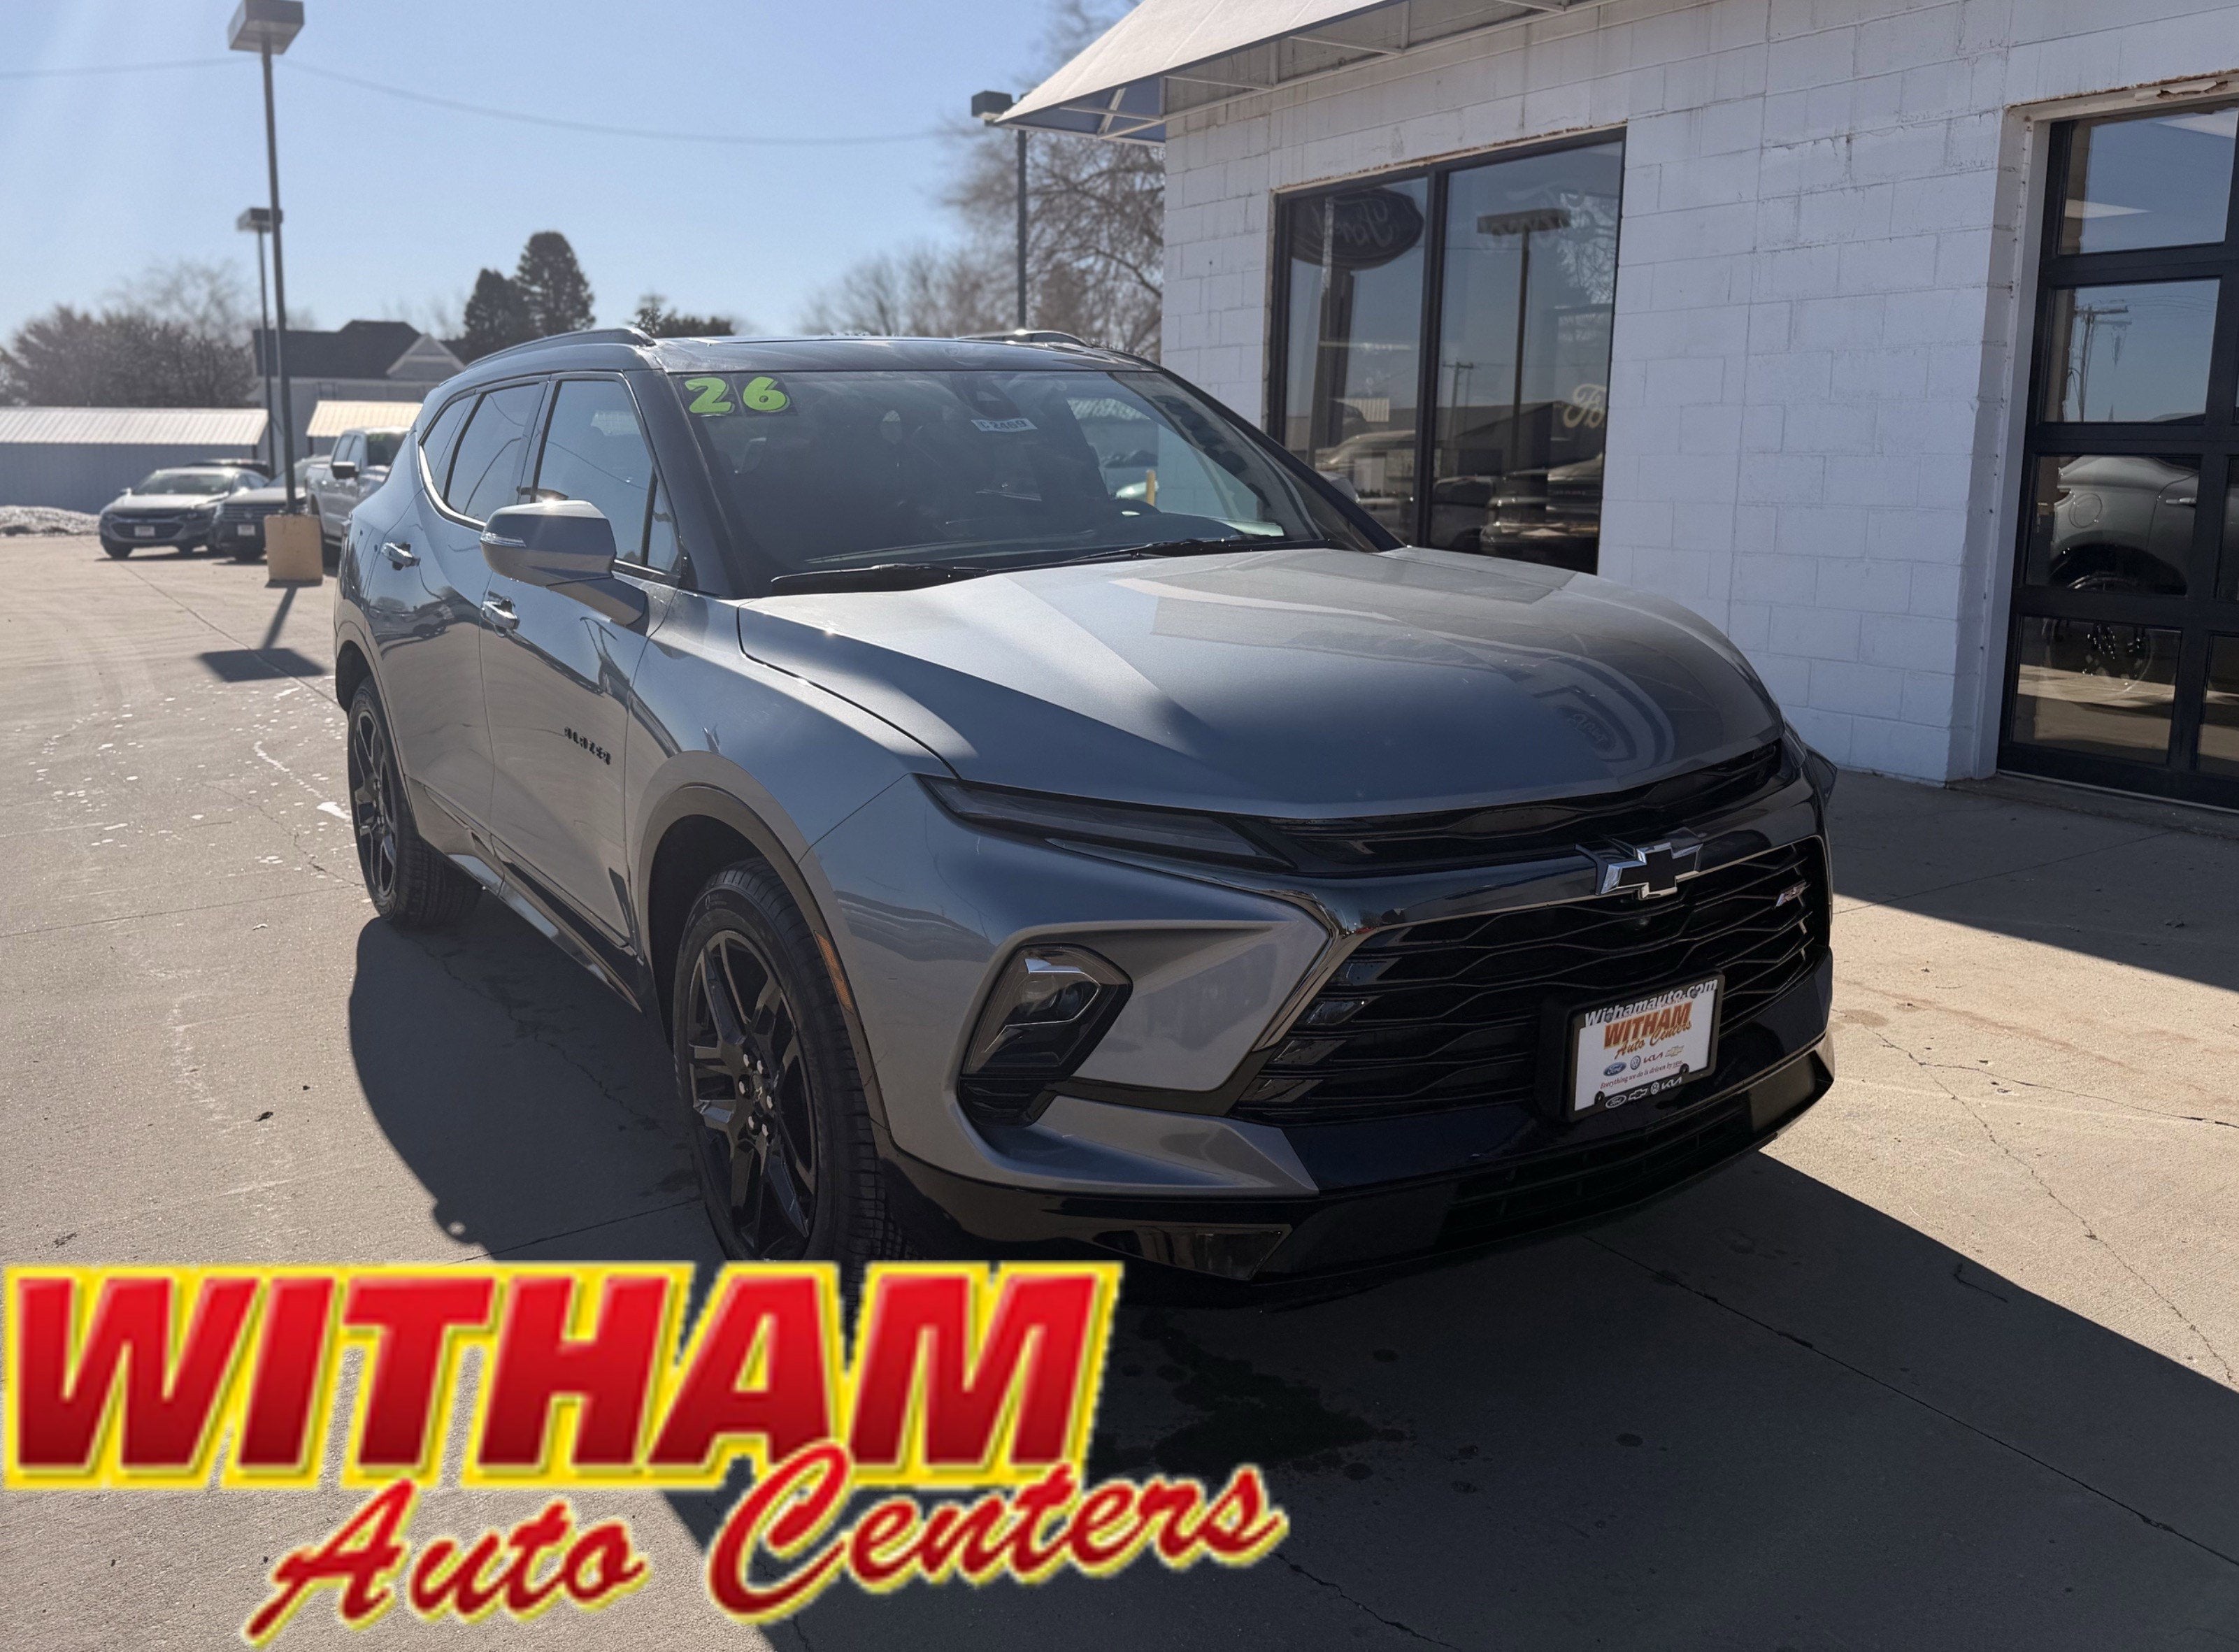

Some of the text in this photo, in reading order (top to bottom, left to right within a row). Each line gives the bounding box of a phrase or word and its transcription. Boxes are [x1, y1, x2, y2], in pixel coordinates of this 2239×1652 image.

[685, 376, 791, 414] 26
[1563, 383, 1607, 428] Fo
[1603, 1001, 1693, 1049] WITHAM
[1615, 1020, 1692, 1059] Auto Centers
[1600, 1076, 1629, 1089] Everything
[1649, 1065, 1666, 1075] driven
[1606, 1063, 1624, 1075] Ford
